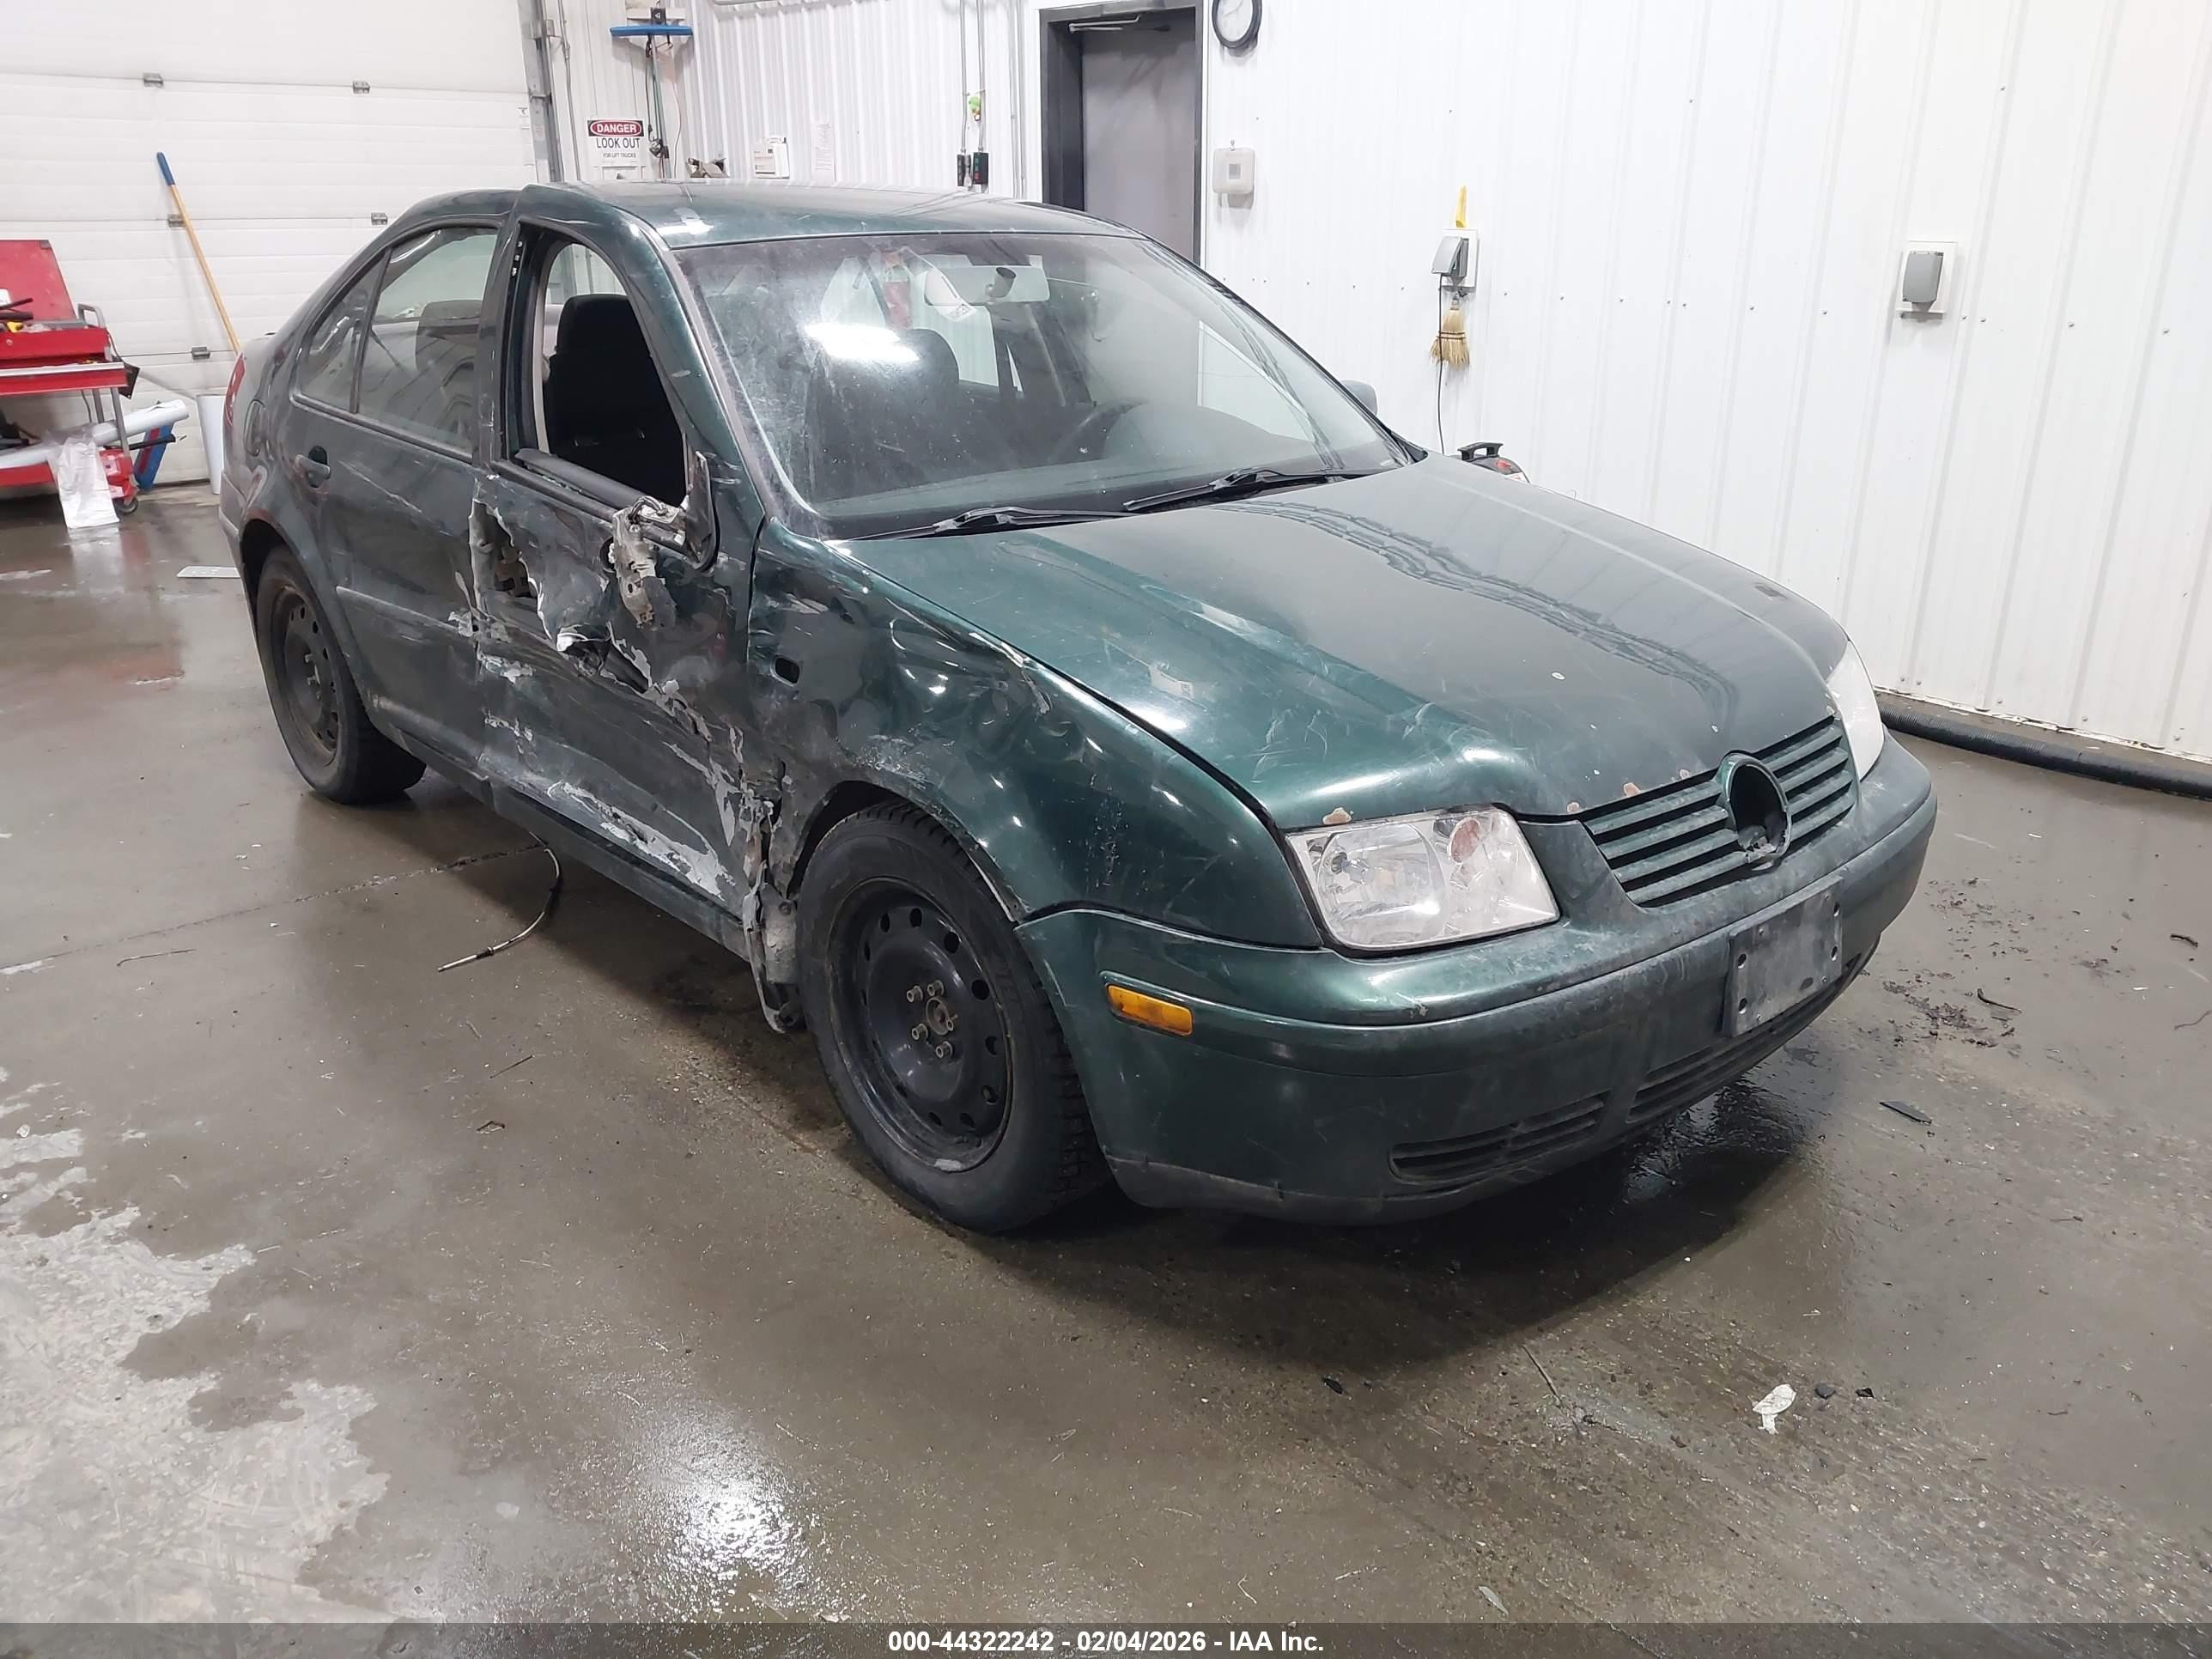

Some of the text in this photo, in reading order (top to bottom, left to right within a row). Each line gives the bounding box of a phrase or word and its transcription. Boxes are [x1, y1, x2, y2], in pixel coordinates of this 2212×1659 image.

[596, 124, 637, 133] DANGER
[597, 137, 640, 149] LOOK OUT
